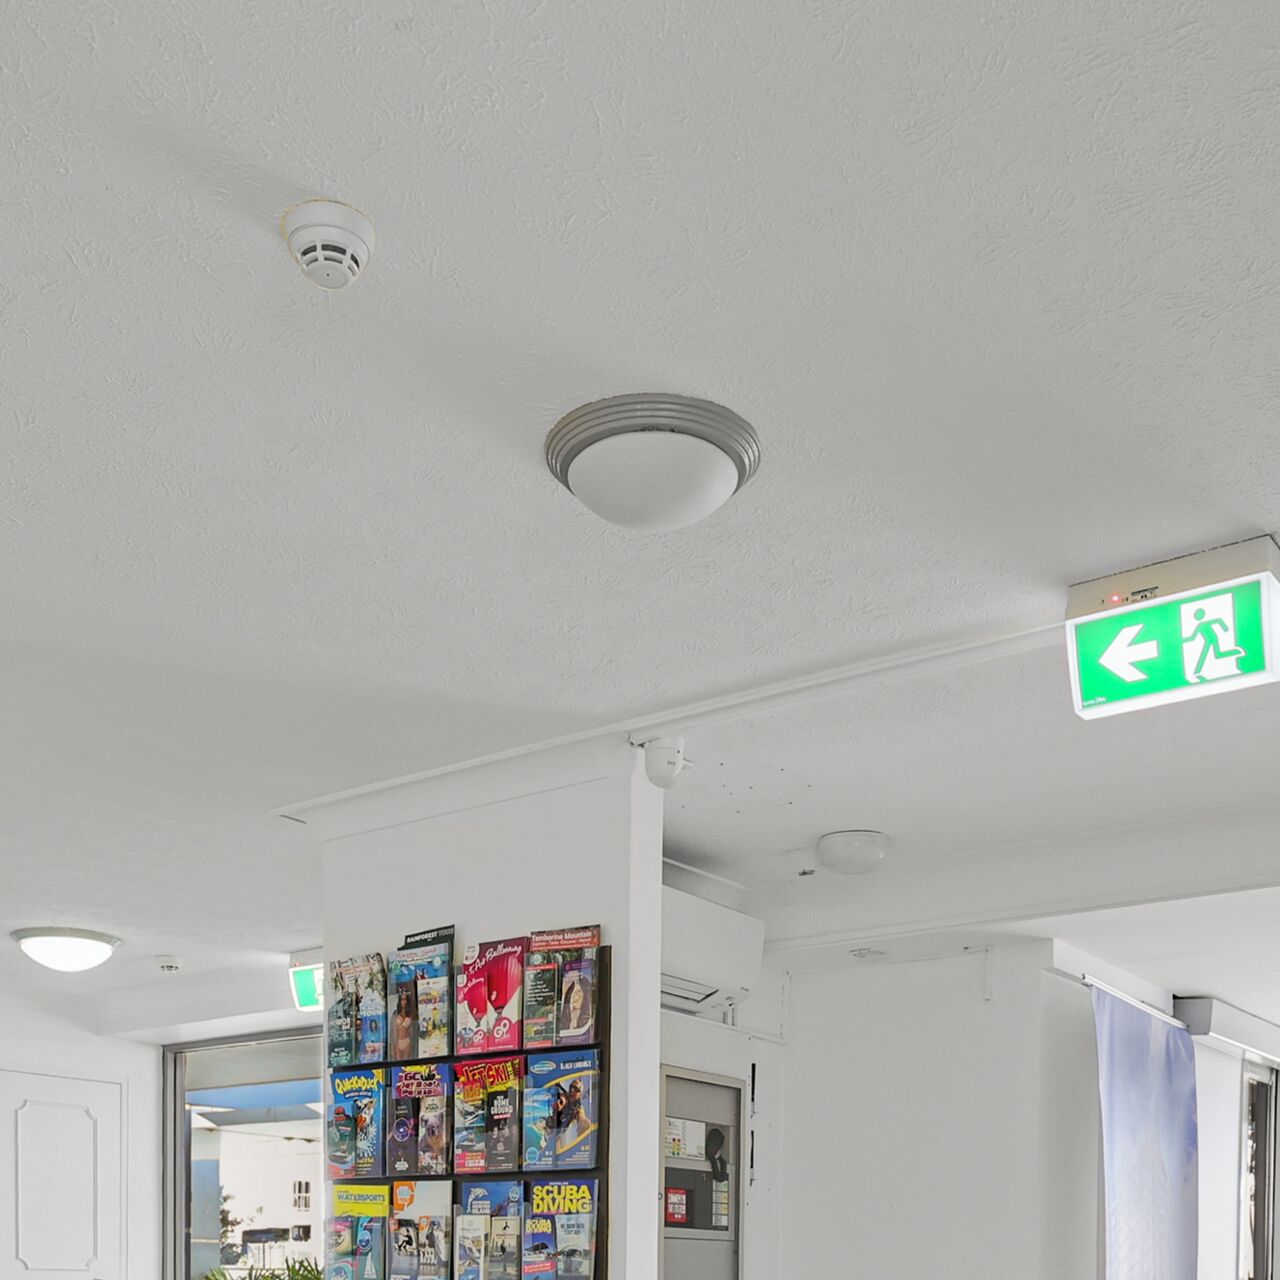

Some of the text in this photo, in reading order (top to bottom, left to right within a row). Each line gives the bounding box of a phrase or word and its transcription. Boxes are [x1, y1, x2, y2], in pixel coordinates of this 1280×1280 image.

[564, 931, 592, 940] Mountain
[533, 1185, 591, 1200] SCUBA
[533, 1199, 592, 1214] DIVING
